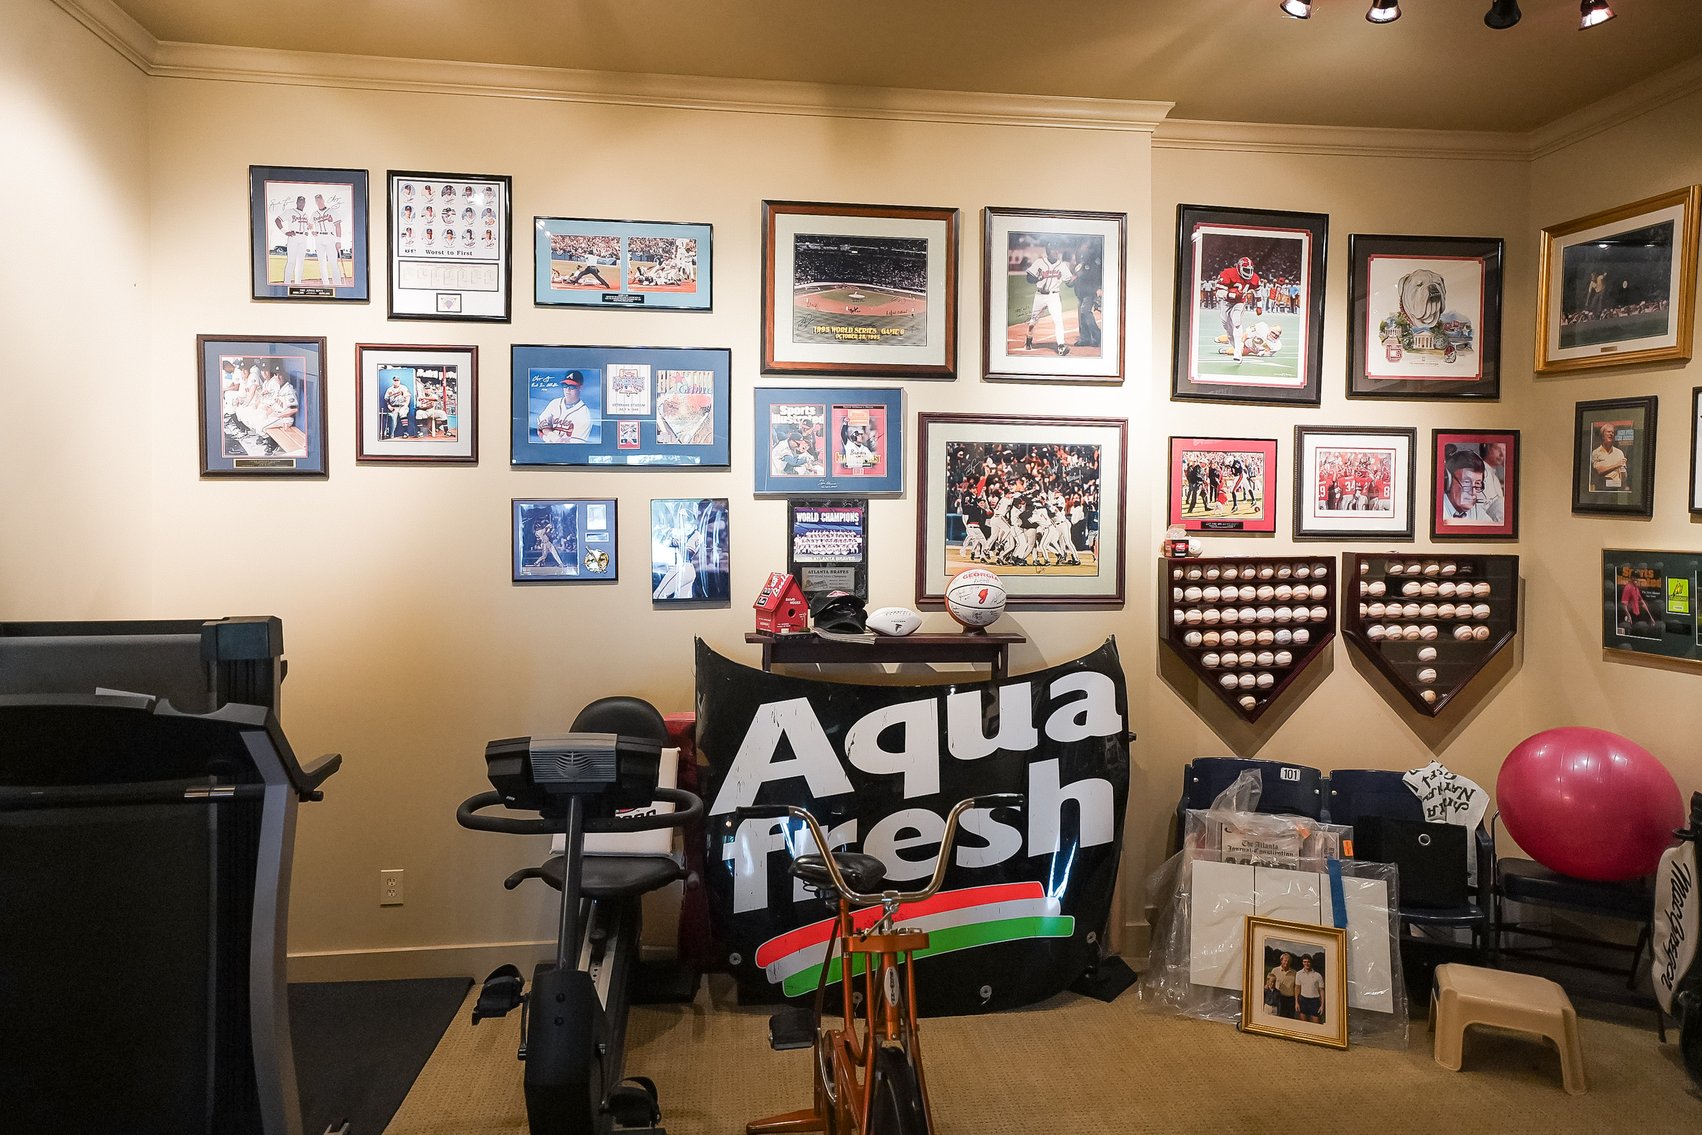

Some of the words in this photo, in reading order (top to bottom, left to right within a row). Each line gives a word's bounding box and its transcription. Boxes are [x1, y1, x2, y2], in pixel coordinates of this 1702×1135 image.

[813, 326, 830, 334] 1995
[831, 326, 854, 334] WORLD
[854, 327, 877, 335] SERIES
[881, 327, 900, 335] GAME
[779, 405, 817, 417] Sports
[796, 512, 820, 523] WORLD
[820, 513, 860, 524] CHAMPIONS
[962, 572, 999, 582] GEORGIA
[708, 670, 1123, 816] Aqua
[1283, 769, 1298, 780] 101
[721, 757, 1115, 914] fresh
[1241, 839, 1254, 847] The
[1255, 840, 1279, 850] Atlanta
[1660, 860, 1692, 992] MacGregor
